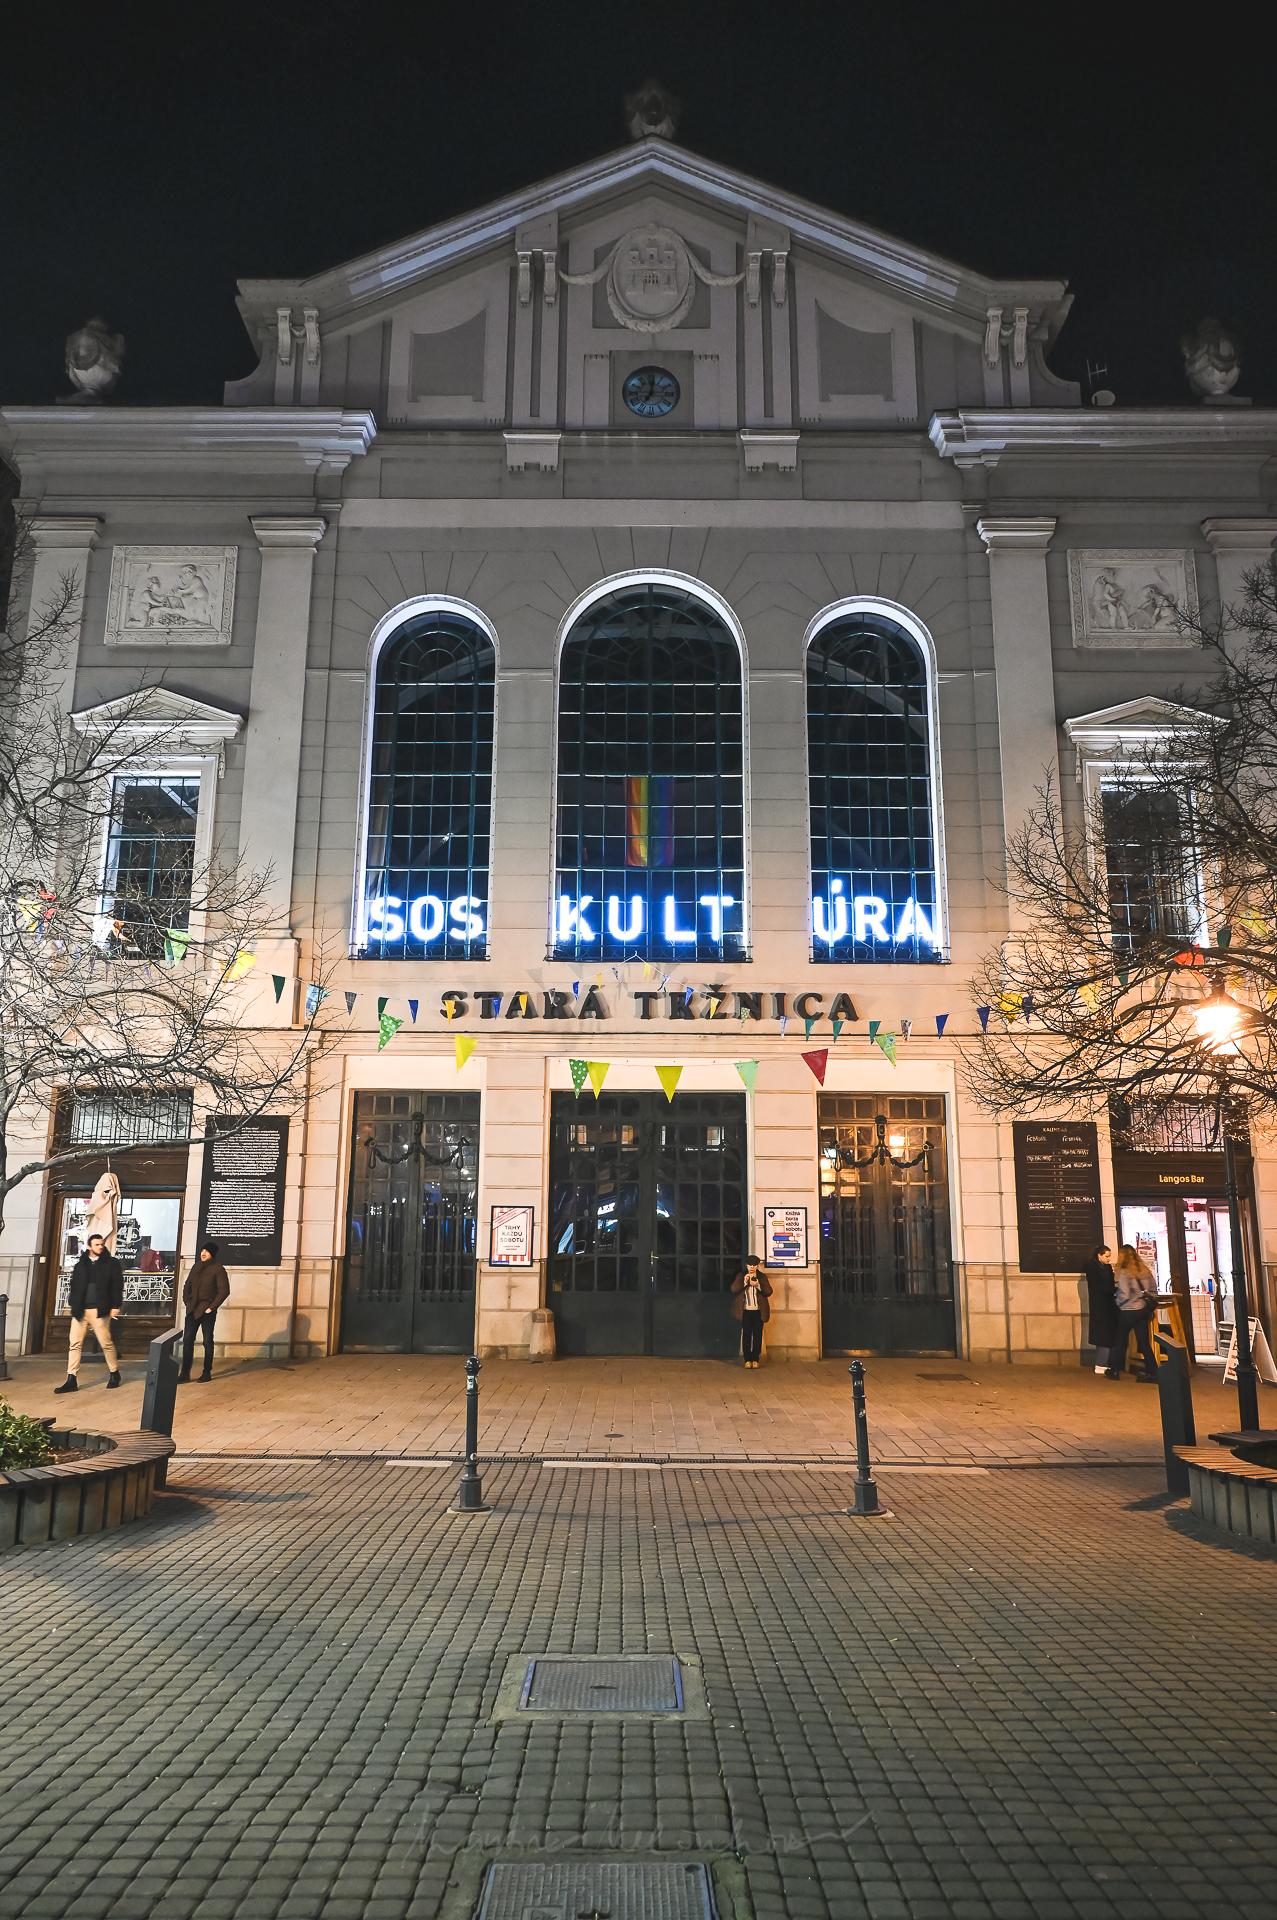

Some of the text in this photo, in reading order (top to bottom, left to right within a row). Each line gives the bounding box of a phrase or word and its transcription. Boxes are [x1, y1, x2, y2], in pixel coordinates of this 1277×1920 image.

[370, 878, 937, 942] SOS KULT ÚRA
[440, 984, 859, 1022] STARÁ TRŽNICA
[1191, 1175, 1205, 1184] Bar
